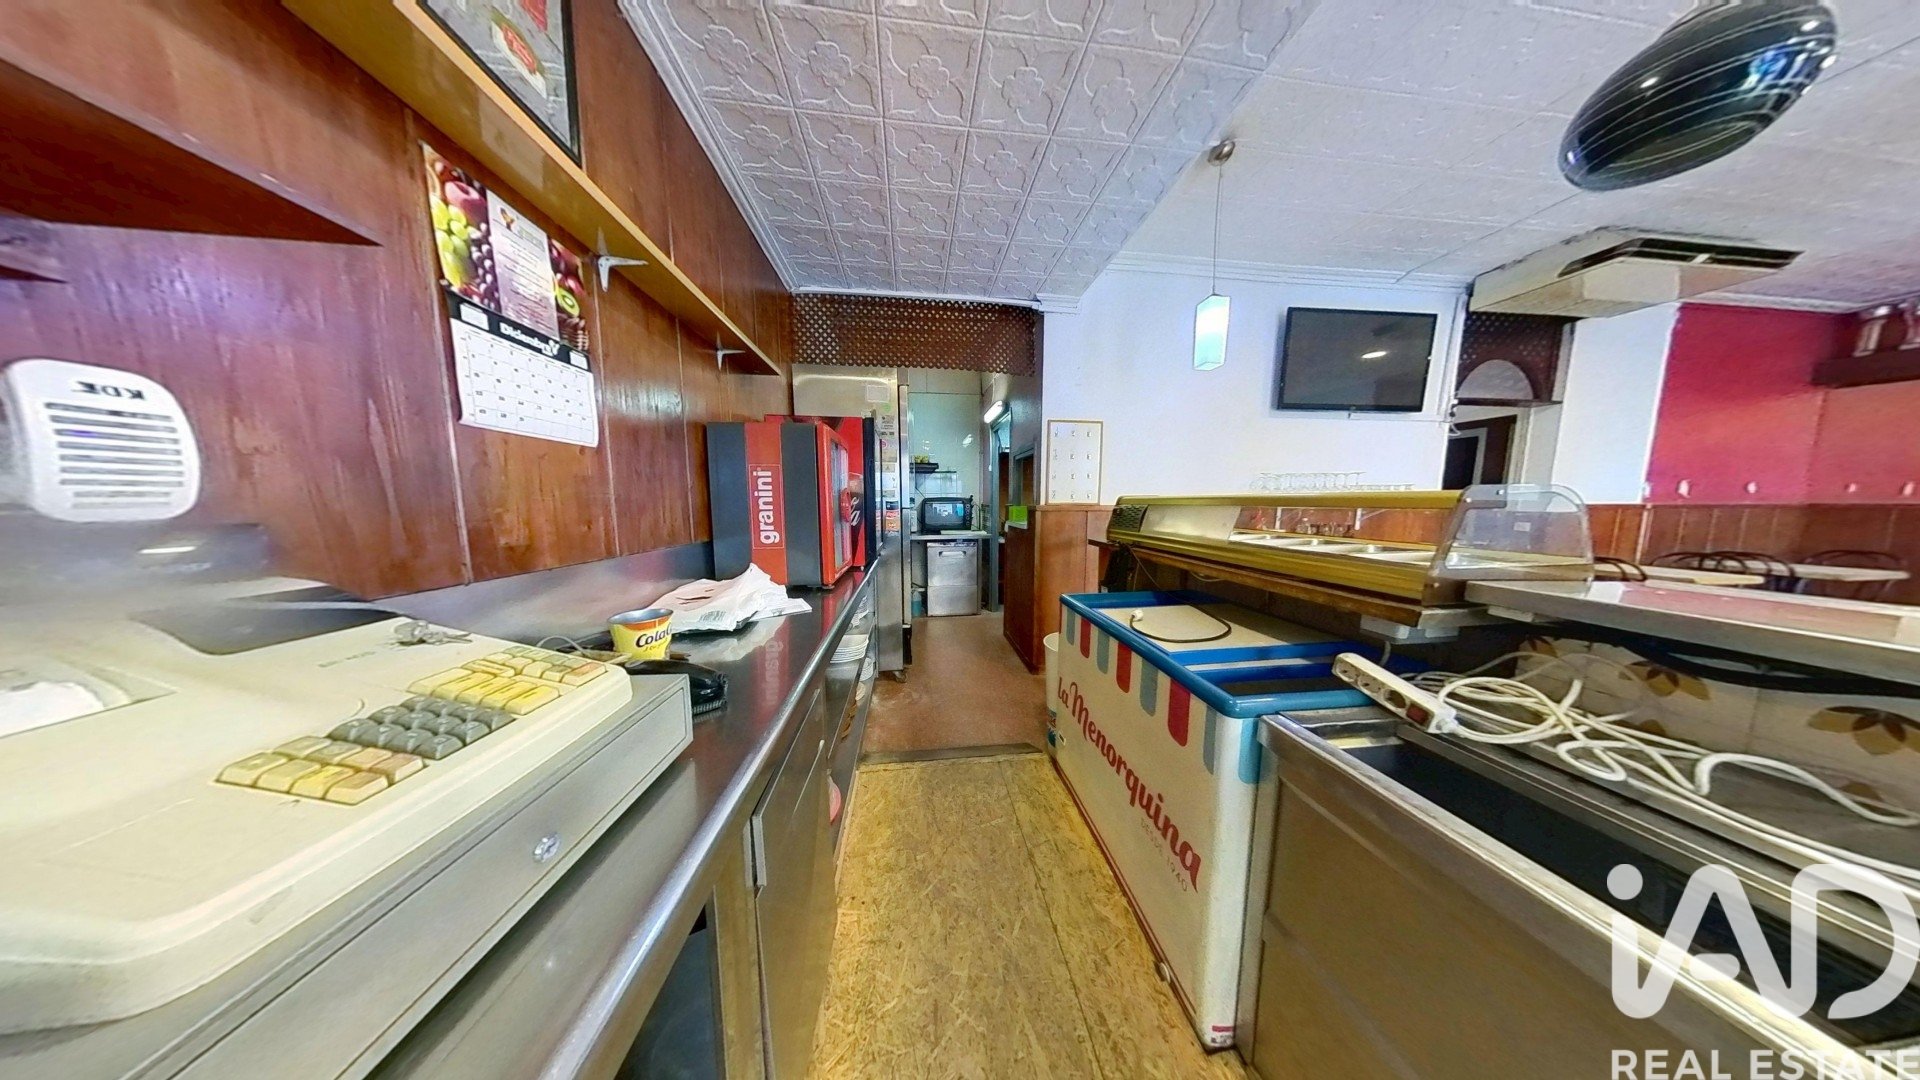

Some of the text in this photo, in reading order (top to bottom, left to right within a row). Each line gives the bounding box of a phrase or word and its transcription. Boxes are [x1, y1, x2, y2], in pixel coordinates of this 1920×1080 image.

[752, 470, 780, 545] granini
[1057, 676, 1202, 894] la Menorquina
